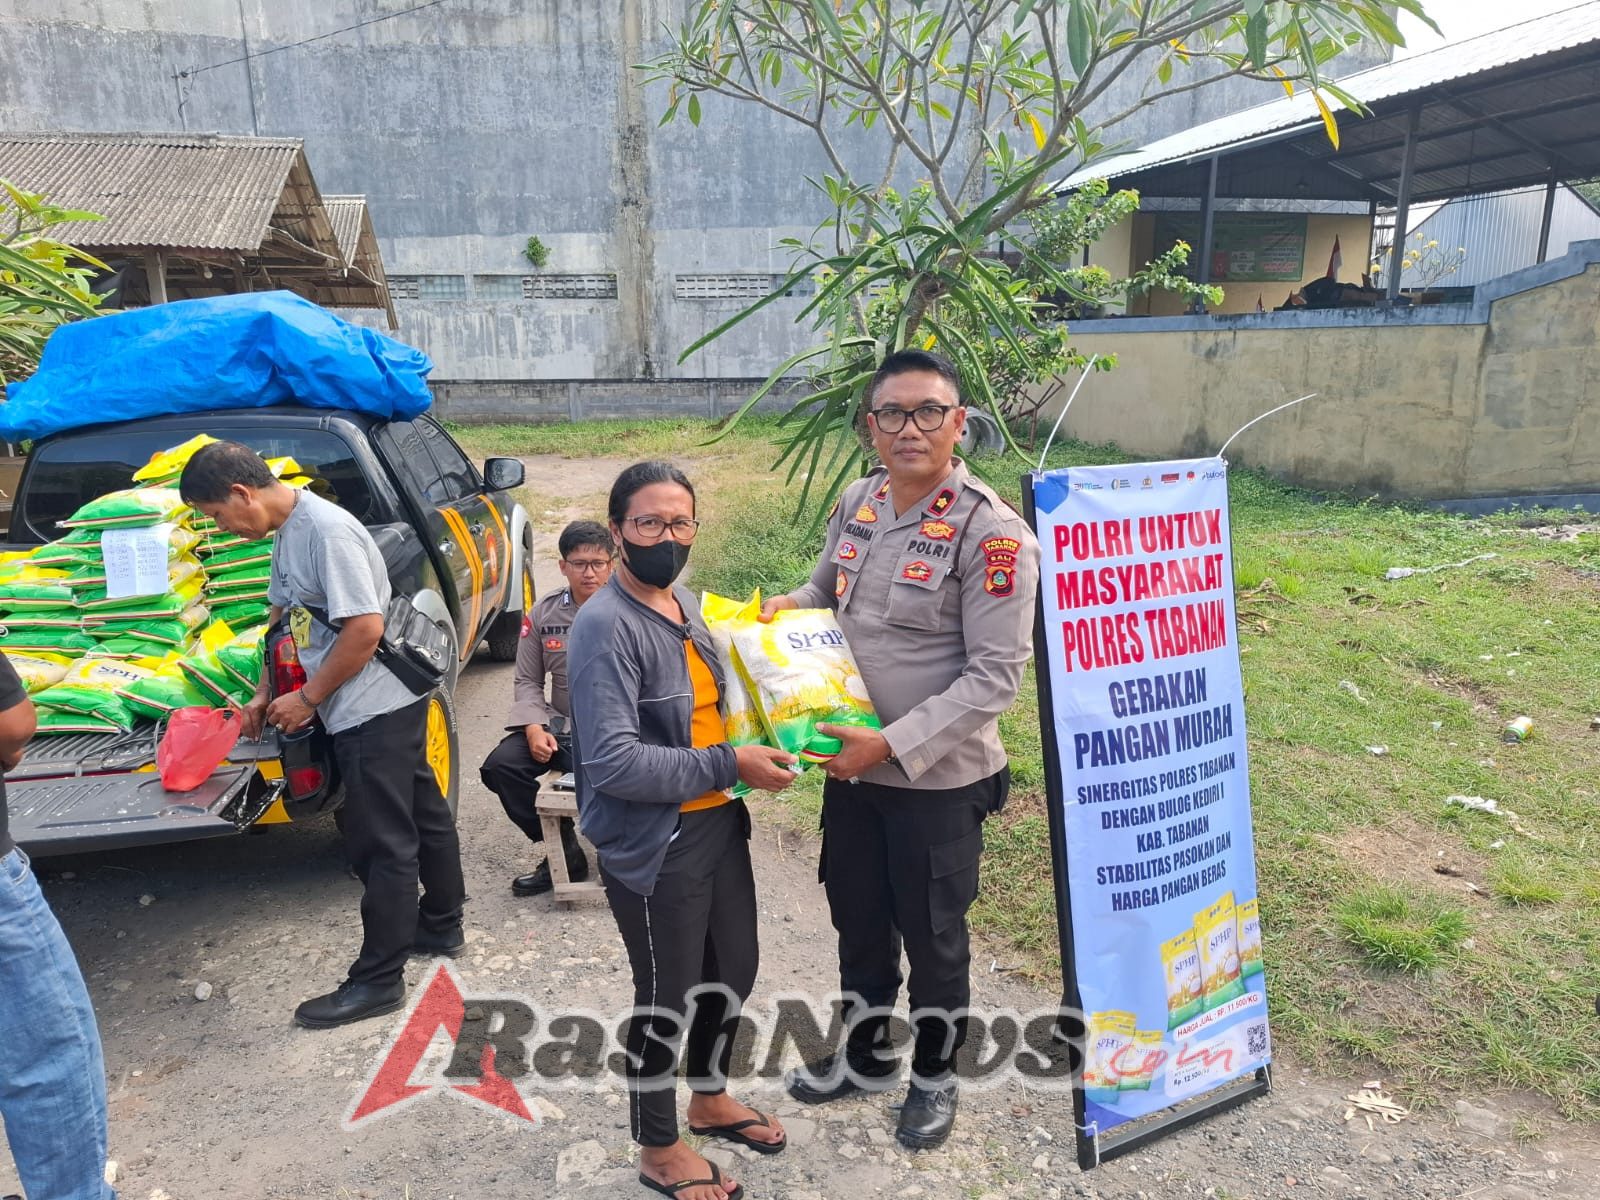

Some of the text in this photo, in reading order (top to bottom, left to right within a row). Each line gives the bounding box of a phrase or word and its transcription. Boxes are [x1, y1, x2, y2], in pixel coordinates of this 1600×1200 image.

[907, 540, 950, 559] POLRI
[984, 539, 1019, 549] POLRES
[1053, 508, 1222, 563] POLRI UNTUK
[1055, 553, 1224, 611] MASYARAKAT
[787, 629, 844, 650] SPHP
[1061, 598, 1227, 673] POLRES TABANAN
[98, 666, 145, 681] SPH
[1108, 667, 1207, 719] GERAKAN
[1073, 703, 1233, 770] PANGAN MURAH
[1077, 752, 1236, 805] SINERGITAS POLRES TABANAN
[1101, 804, 1156, 830] DENGAN
[1158, 795, 1191, 821] BULOG
[1193, 785, 1219, 812] KEDIRI
[1136, 815, 1210, 853] KAB. TABANAN
[1096, 831, 1232, 886] STABILITAS PASOKAN DAN
[1111, 859, 1227, 912] HARGA PANGAN BERAS
[1210, 927, 1233, 952] SPHP
[1174, 954, 1198, 975] SPHP
[1096, 1037, 1124, 1050] SPHP
[1177, 1022, 1199, 1038] HARGA
[1200, 1014, 1213, 1027] JUAL
